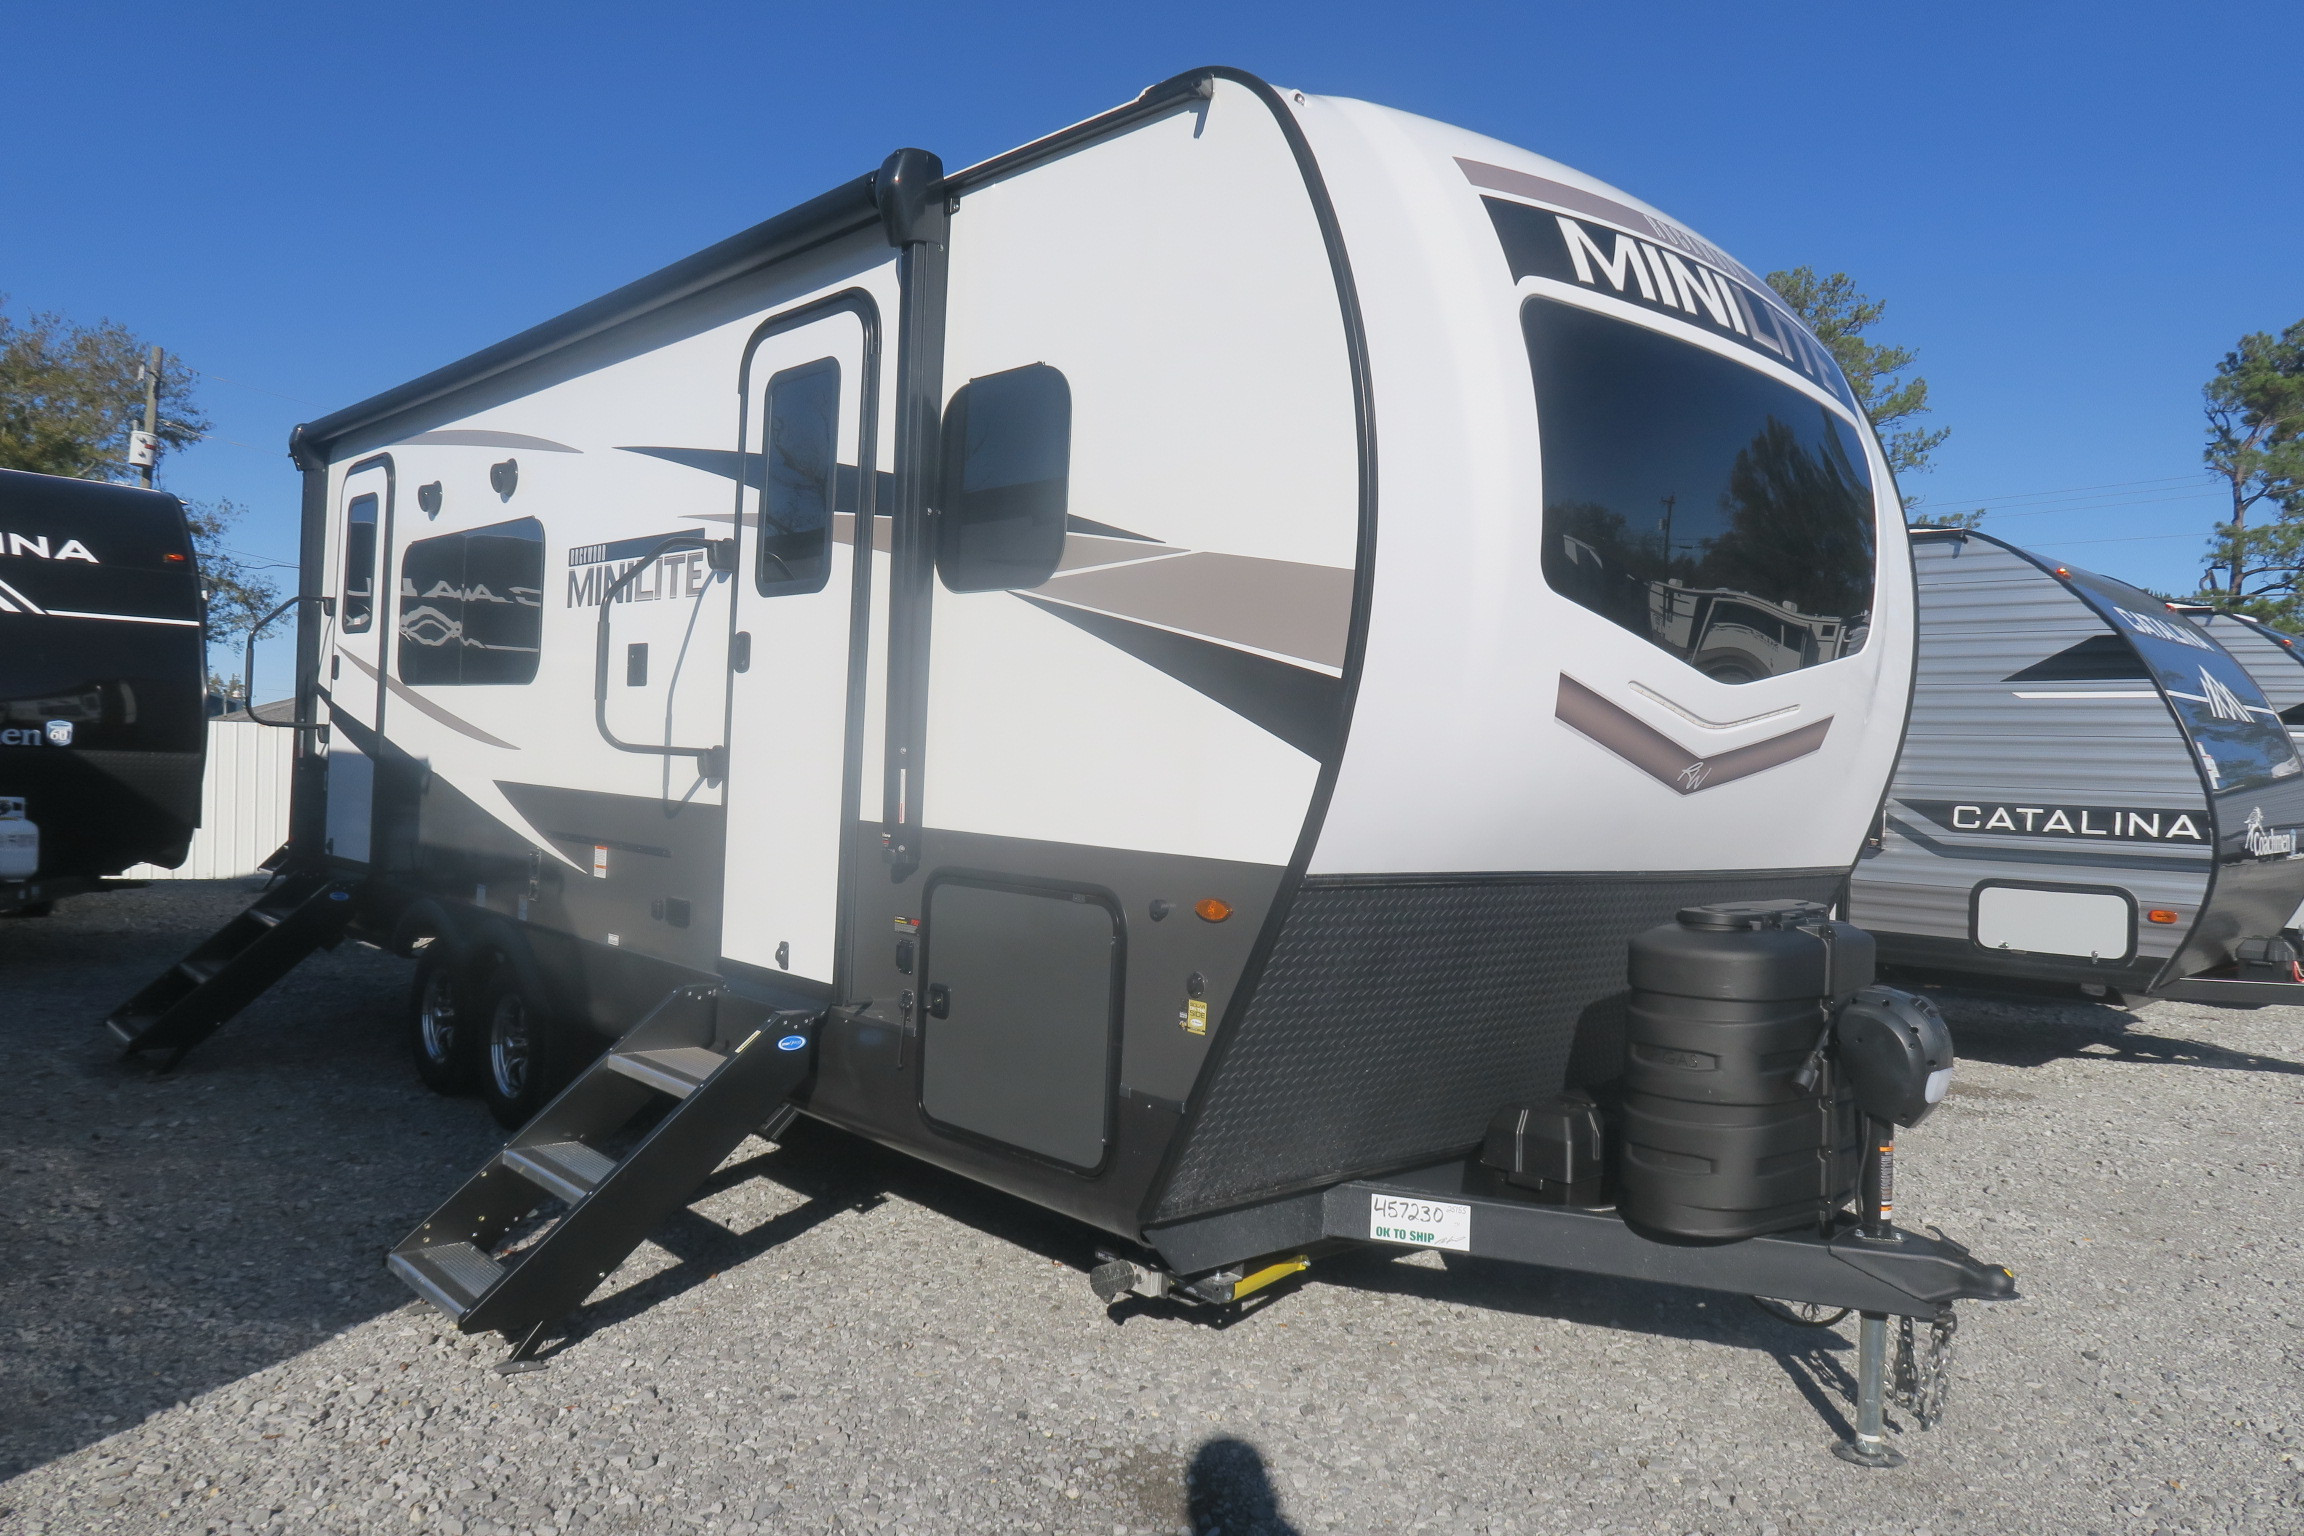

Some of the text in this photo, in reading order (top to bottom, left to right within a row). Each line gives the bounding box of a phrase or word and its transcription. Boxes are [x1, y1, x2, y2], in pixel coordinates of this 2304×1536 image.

[2112, 606, 2216, 652] CATALINA
[1952, 805, 2202, 840] CATALINA
[1374, 1197, 1444, 1223] 457230
[1376, 1226, 1391, 1238] OK
[1393, 1228, 1406, 1240] TO
[1409, 1230, 1435, 1243] SHIP
